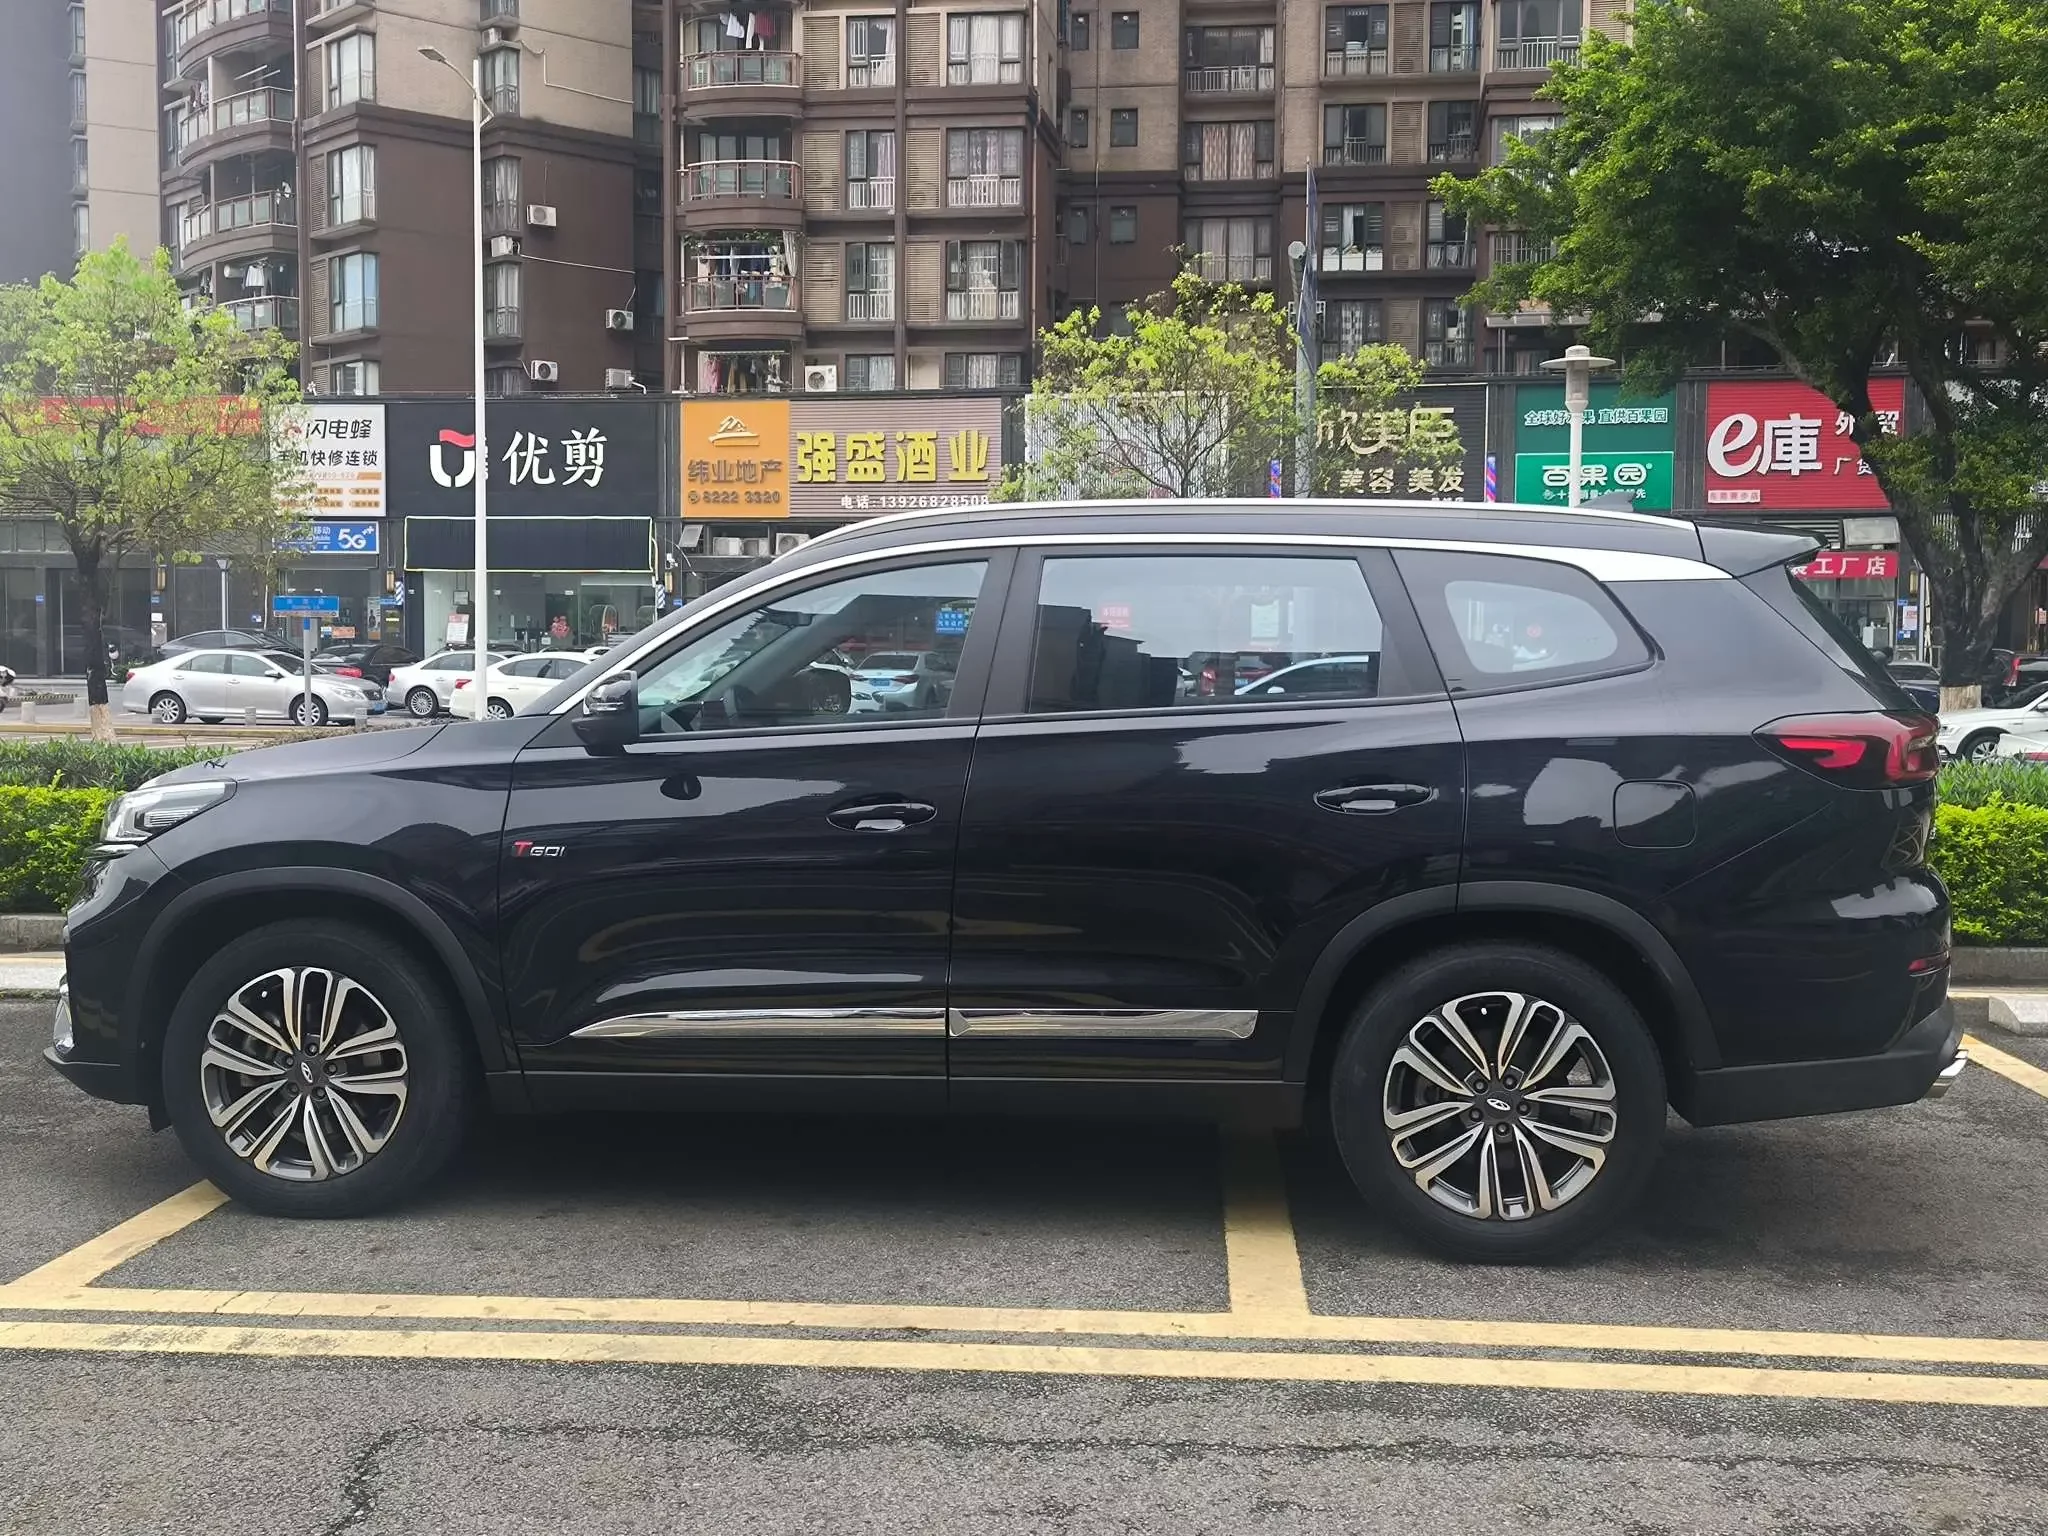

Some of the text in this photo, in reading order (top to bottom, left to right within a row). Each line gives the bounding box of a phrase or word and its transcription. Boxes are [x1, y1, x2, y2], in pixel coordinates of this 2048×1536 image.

[305, 418, 373, 440] 闪电蜂
[1598, 407, 1668, 424] 直供百果园
[502, 426, 608, 488] 优剪
[797, 430, 990, 482] 强盛酒业
[687, 459, 783, 485] 纬业地产
[1407, 464, 1465, 493] 美发
